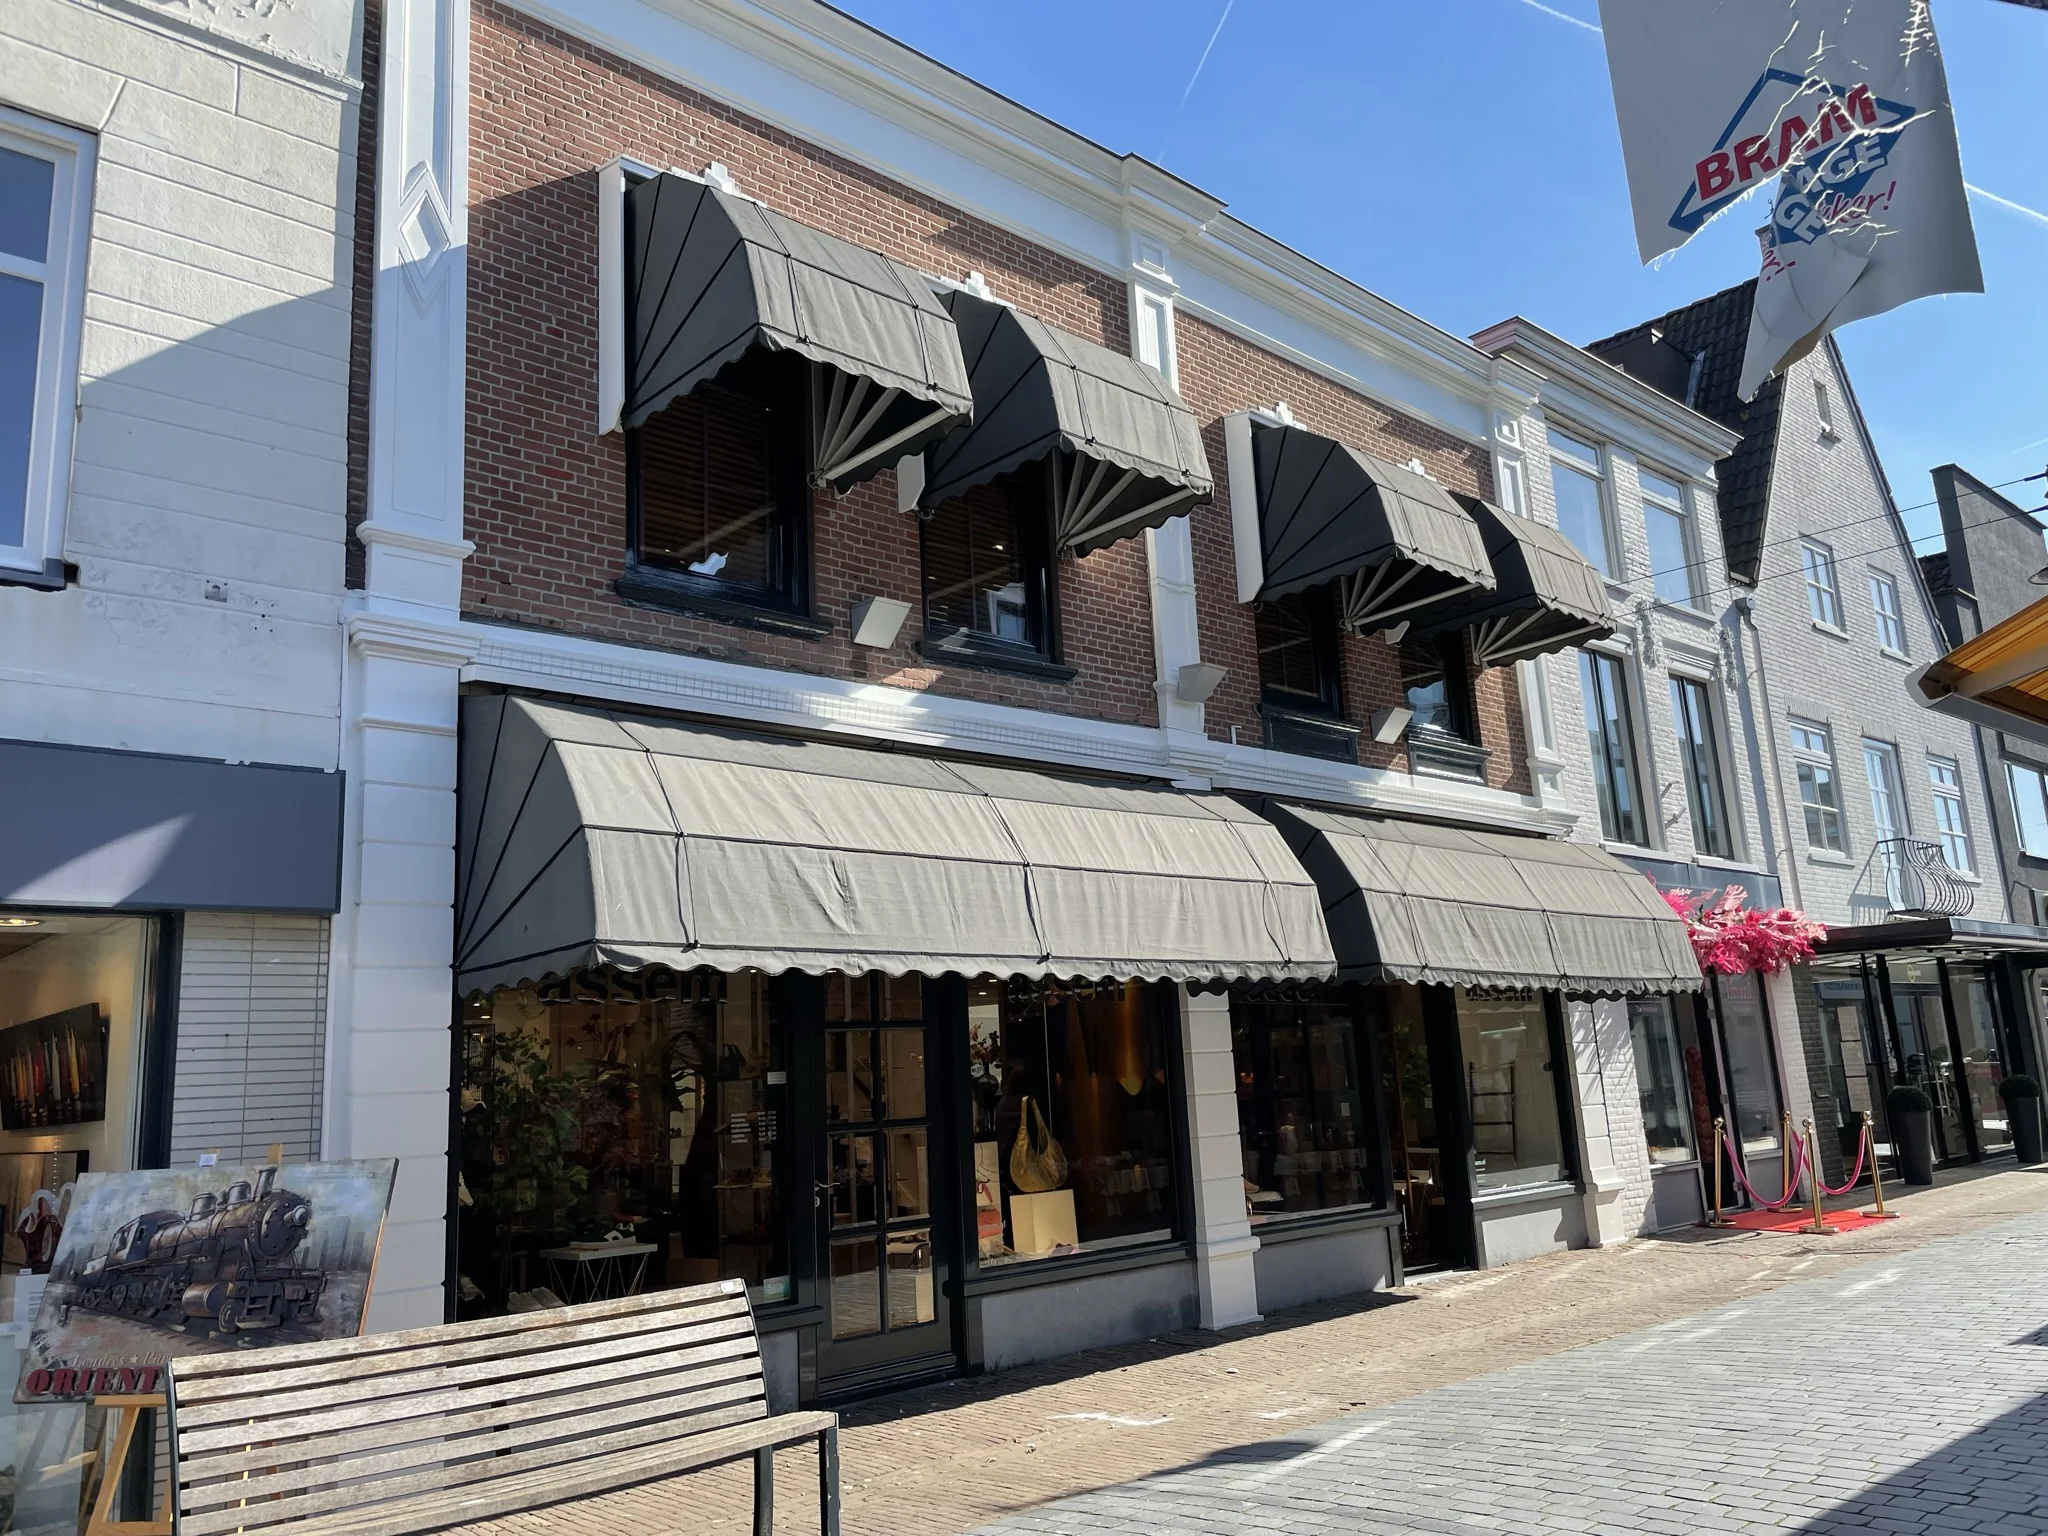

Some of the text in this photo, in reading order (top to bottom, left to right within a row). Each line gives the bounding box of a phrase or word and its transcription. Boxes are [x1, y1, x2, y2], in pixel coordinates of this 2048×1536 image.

[1695, 84, 1878, 201] BRAM
[538, 963, 729, 1005] assem
[73, 1354, 125, 1369] Londres
[26, 1366, 163, 1395] ORIENT
